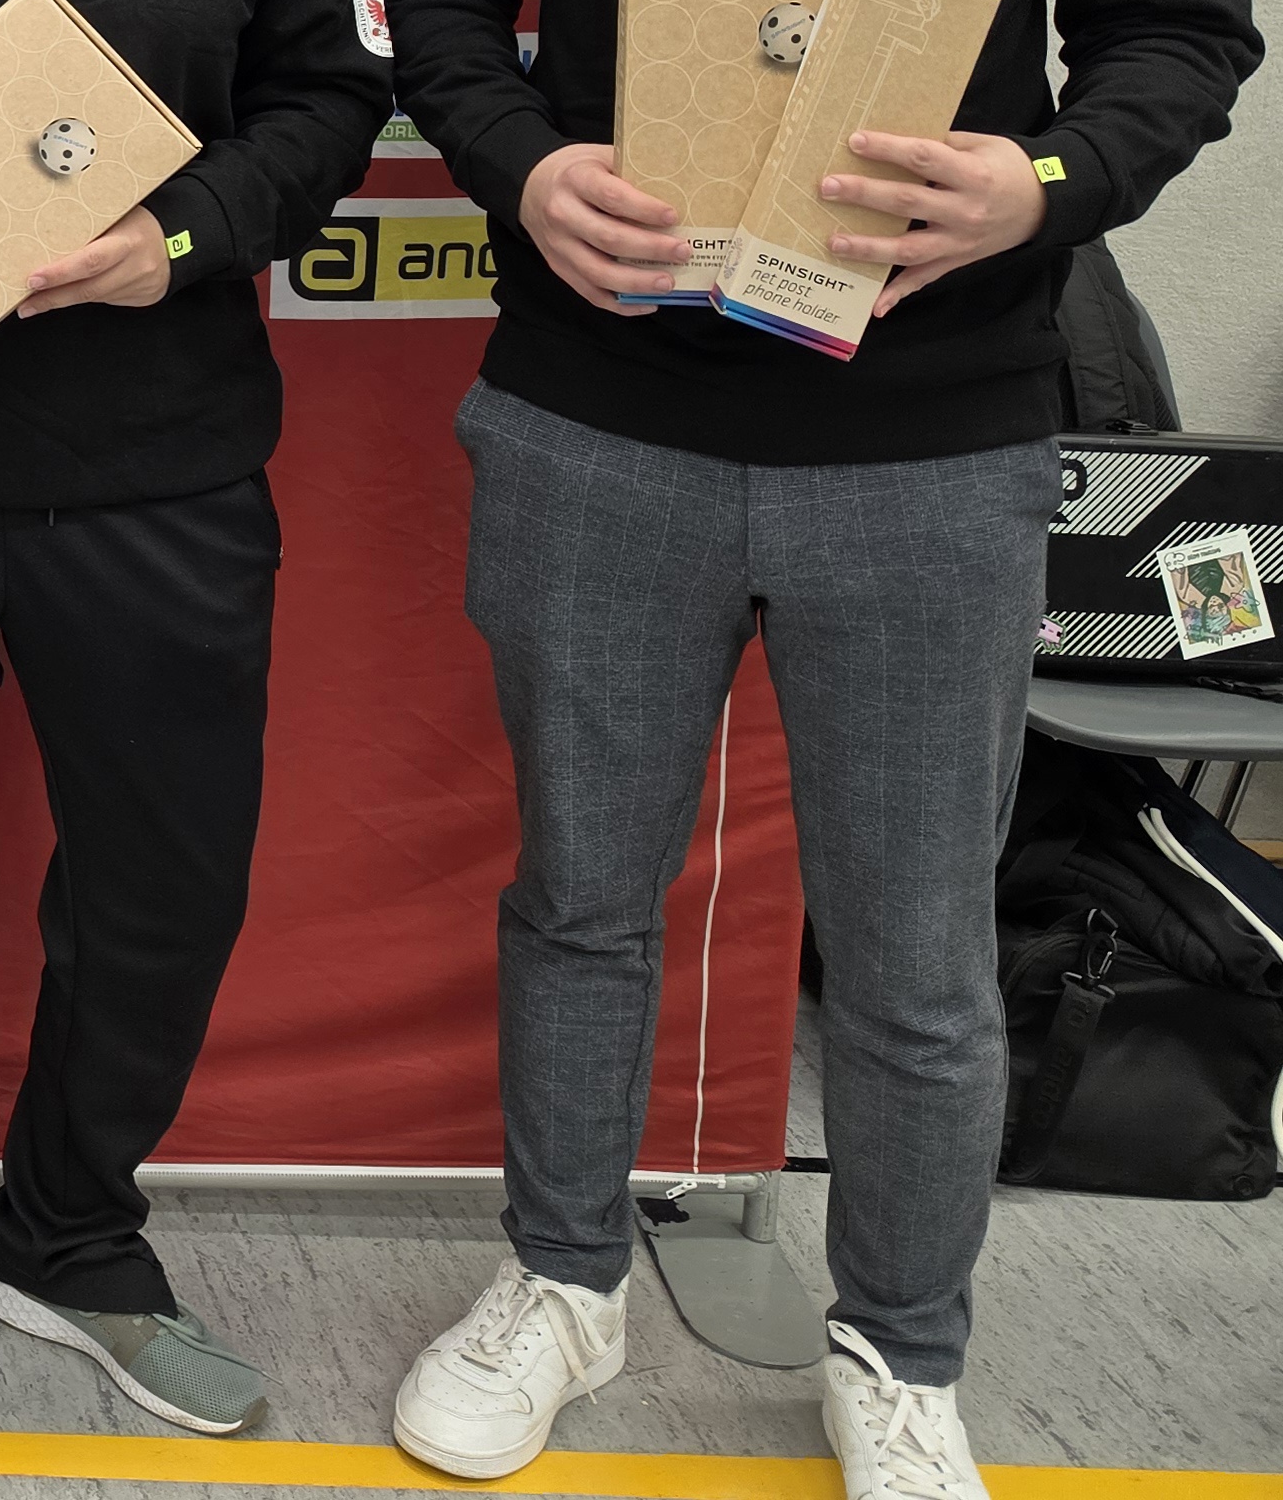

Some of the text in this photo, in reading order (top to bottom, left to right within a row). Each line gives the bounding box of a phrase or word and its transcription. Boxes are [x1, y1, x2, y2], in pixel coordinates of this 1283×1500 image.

[750, 268, 812, 299] net post
[742, 283, 842, 325] phone holder
